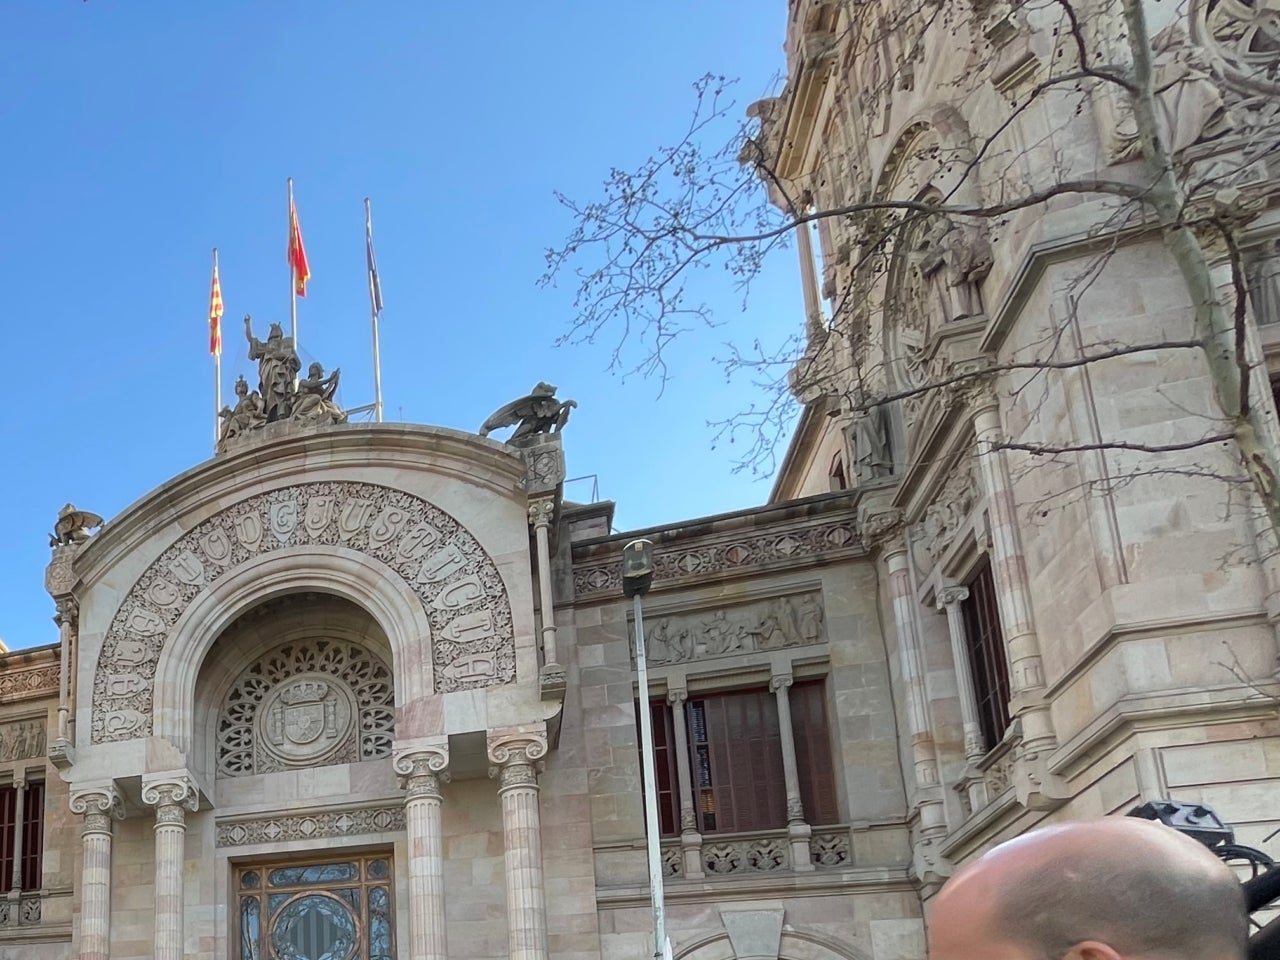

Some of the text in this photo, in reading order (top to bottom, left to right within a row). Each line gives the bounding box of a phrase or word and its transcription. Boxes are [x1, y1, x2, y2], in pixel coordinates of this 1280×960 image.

[106, 498, 498, 734] PALACIO DE JUSTICIA
